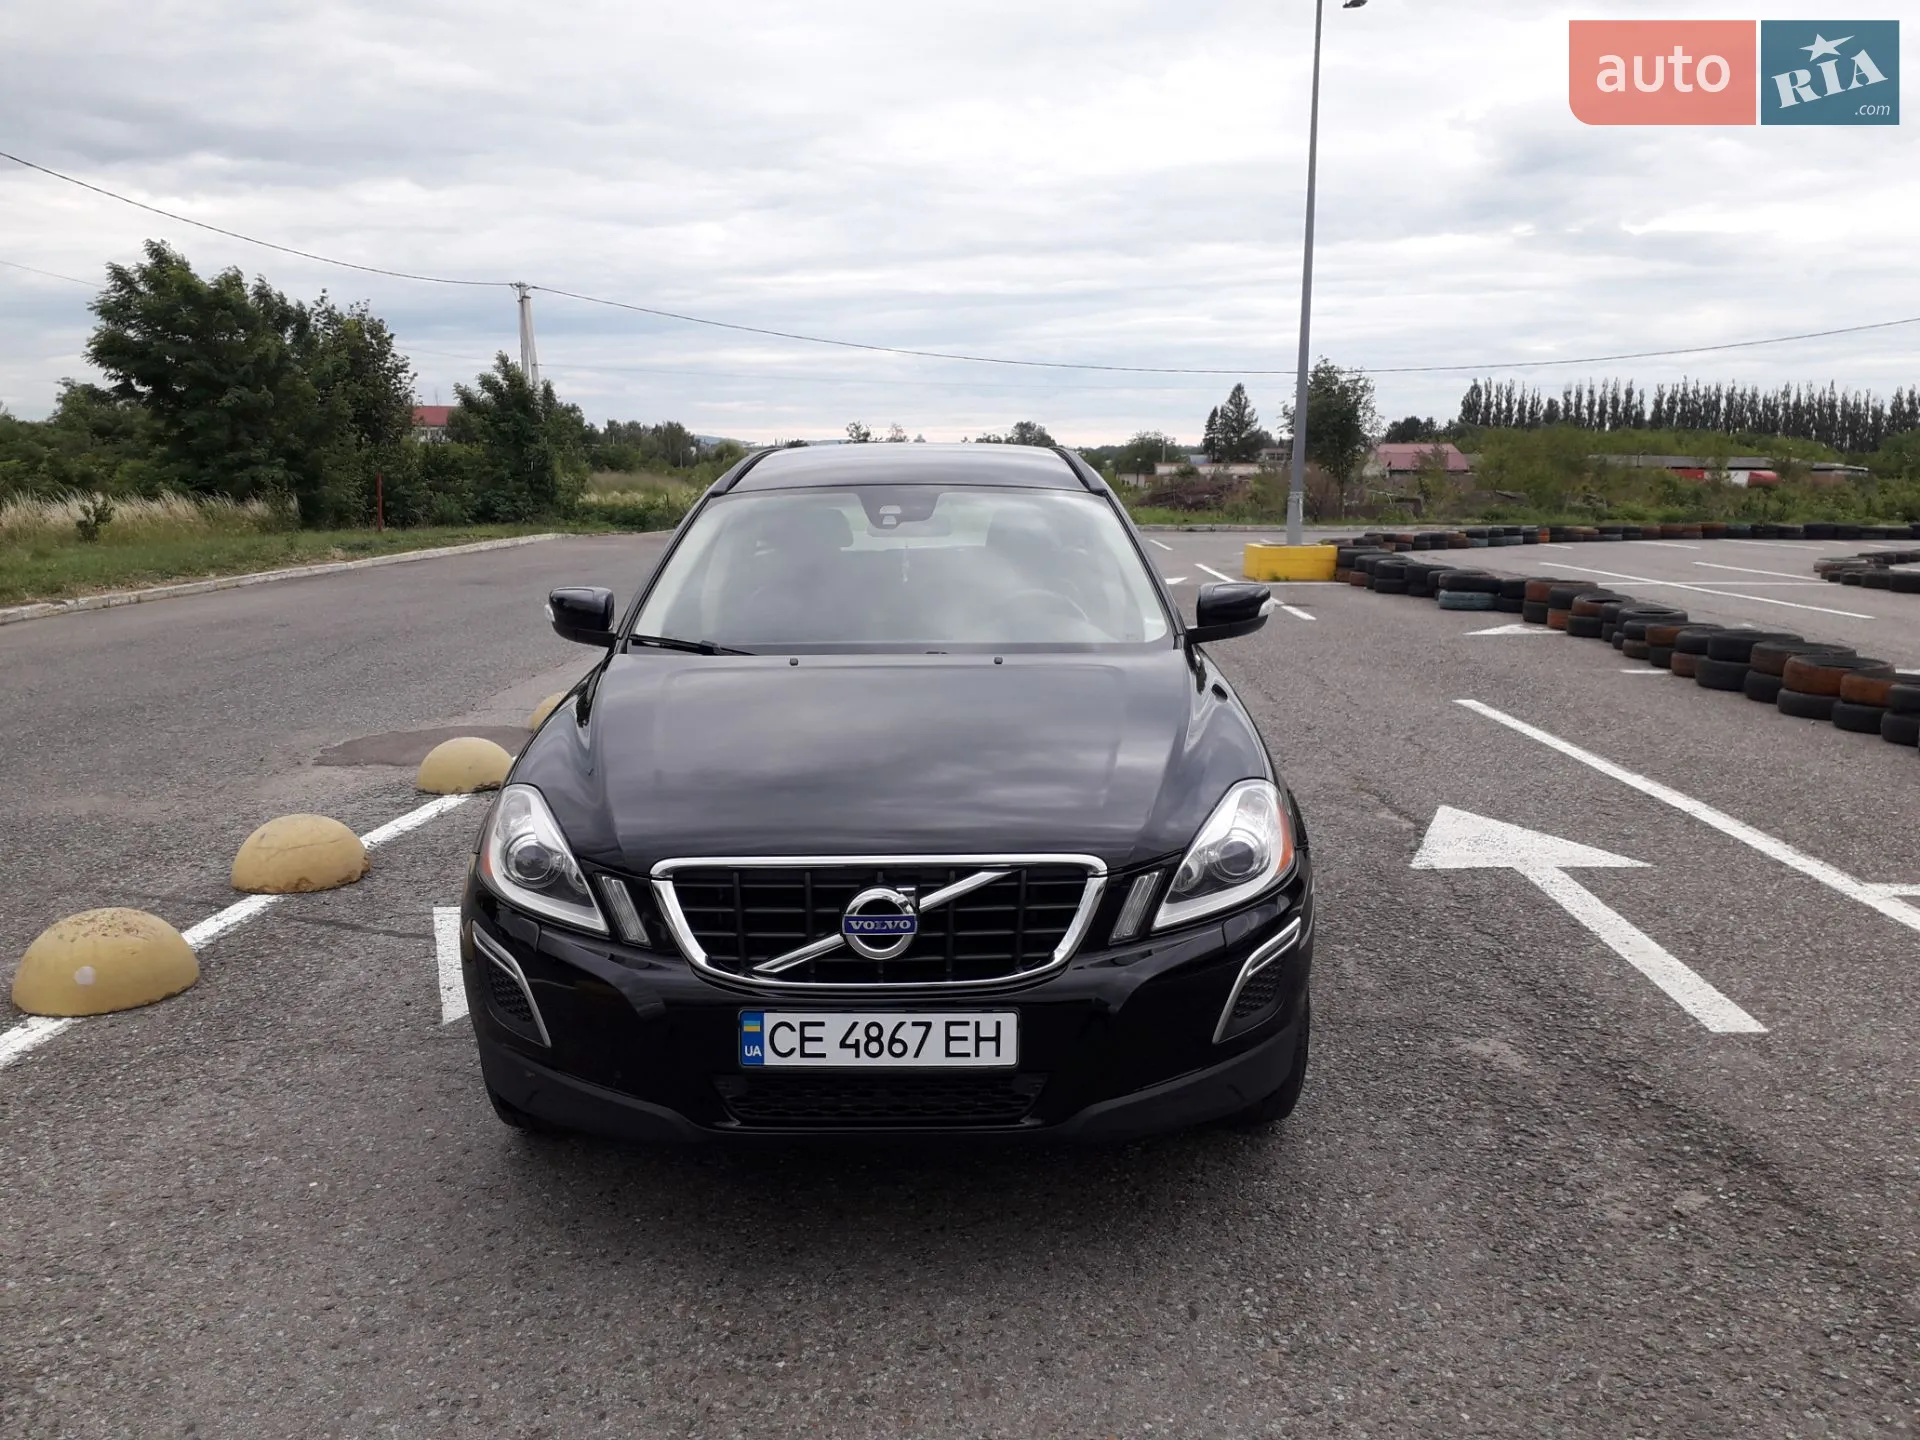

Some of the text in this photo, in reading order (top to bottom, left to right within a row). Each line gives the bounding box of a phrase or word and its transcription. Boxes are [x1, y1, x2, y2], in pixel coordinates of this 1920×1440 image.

[848, 920, 911, 930] VOLVO
[768, 1021, 1001, 1058] CE 4867 EH
[744, 1045, 762, 1057] UA
